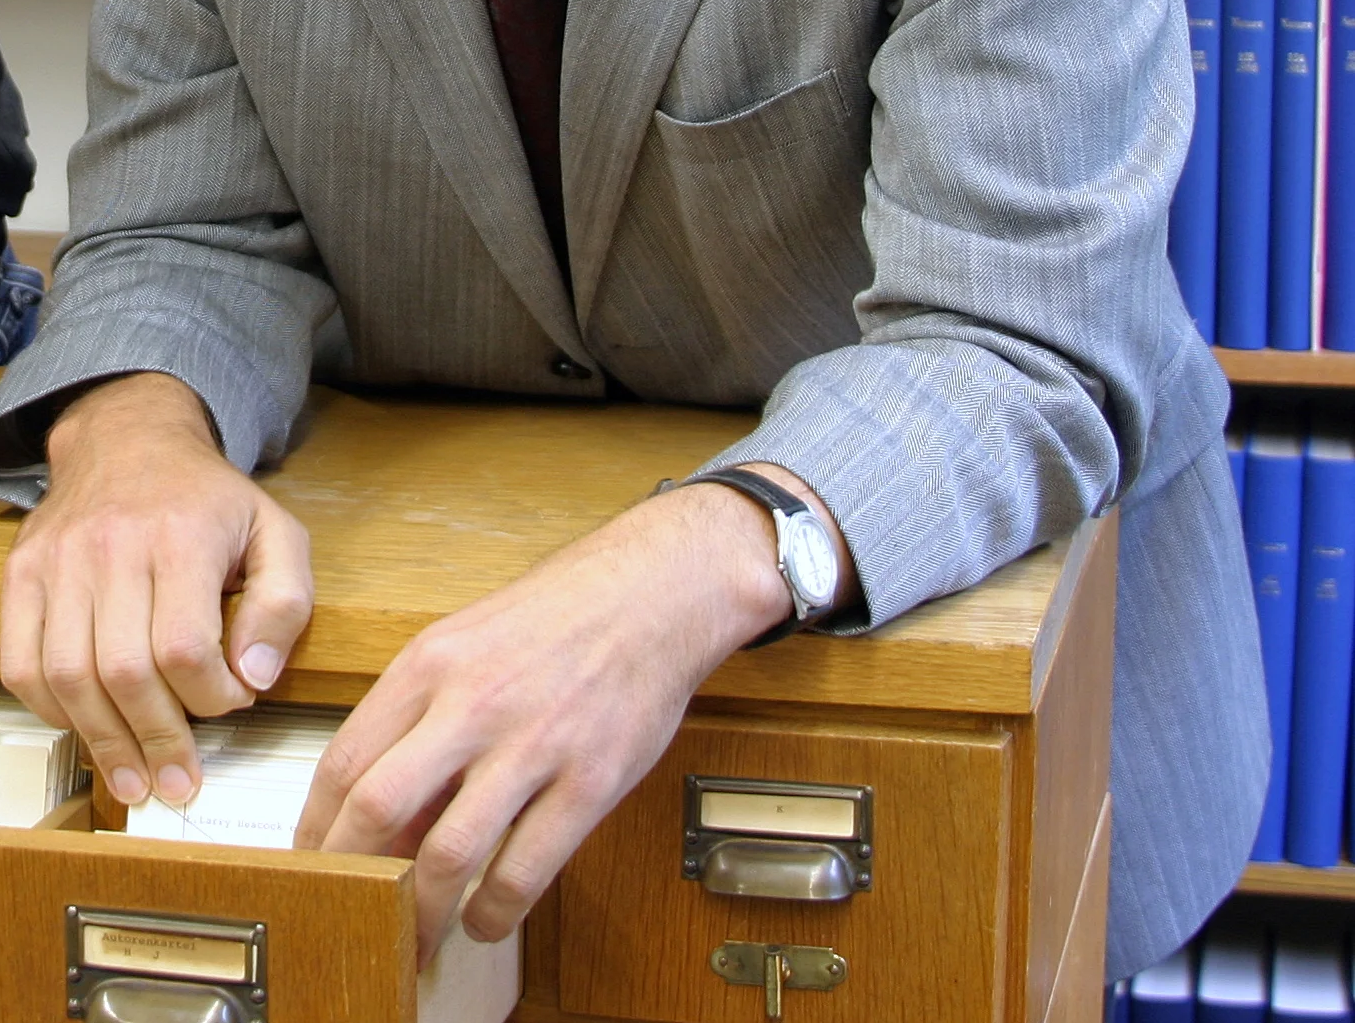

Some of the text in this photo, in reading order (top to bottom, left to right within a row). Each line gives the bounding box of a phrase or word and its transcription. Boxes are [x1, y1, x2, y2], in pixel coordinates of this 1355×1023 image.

[776, 805, 784, 813] K
[102, 933, 197, 952] Autorenkartei
[124, 947, 160, 960] H J
